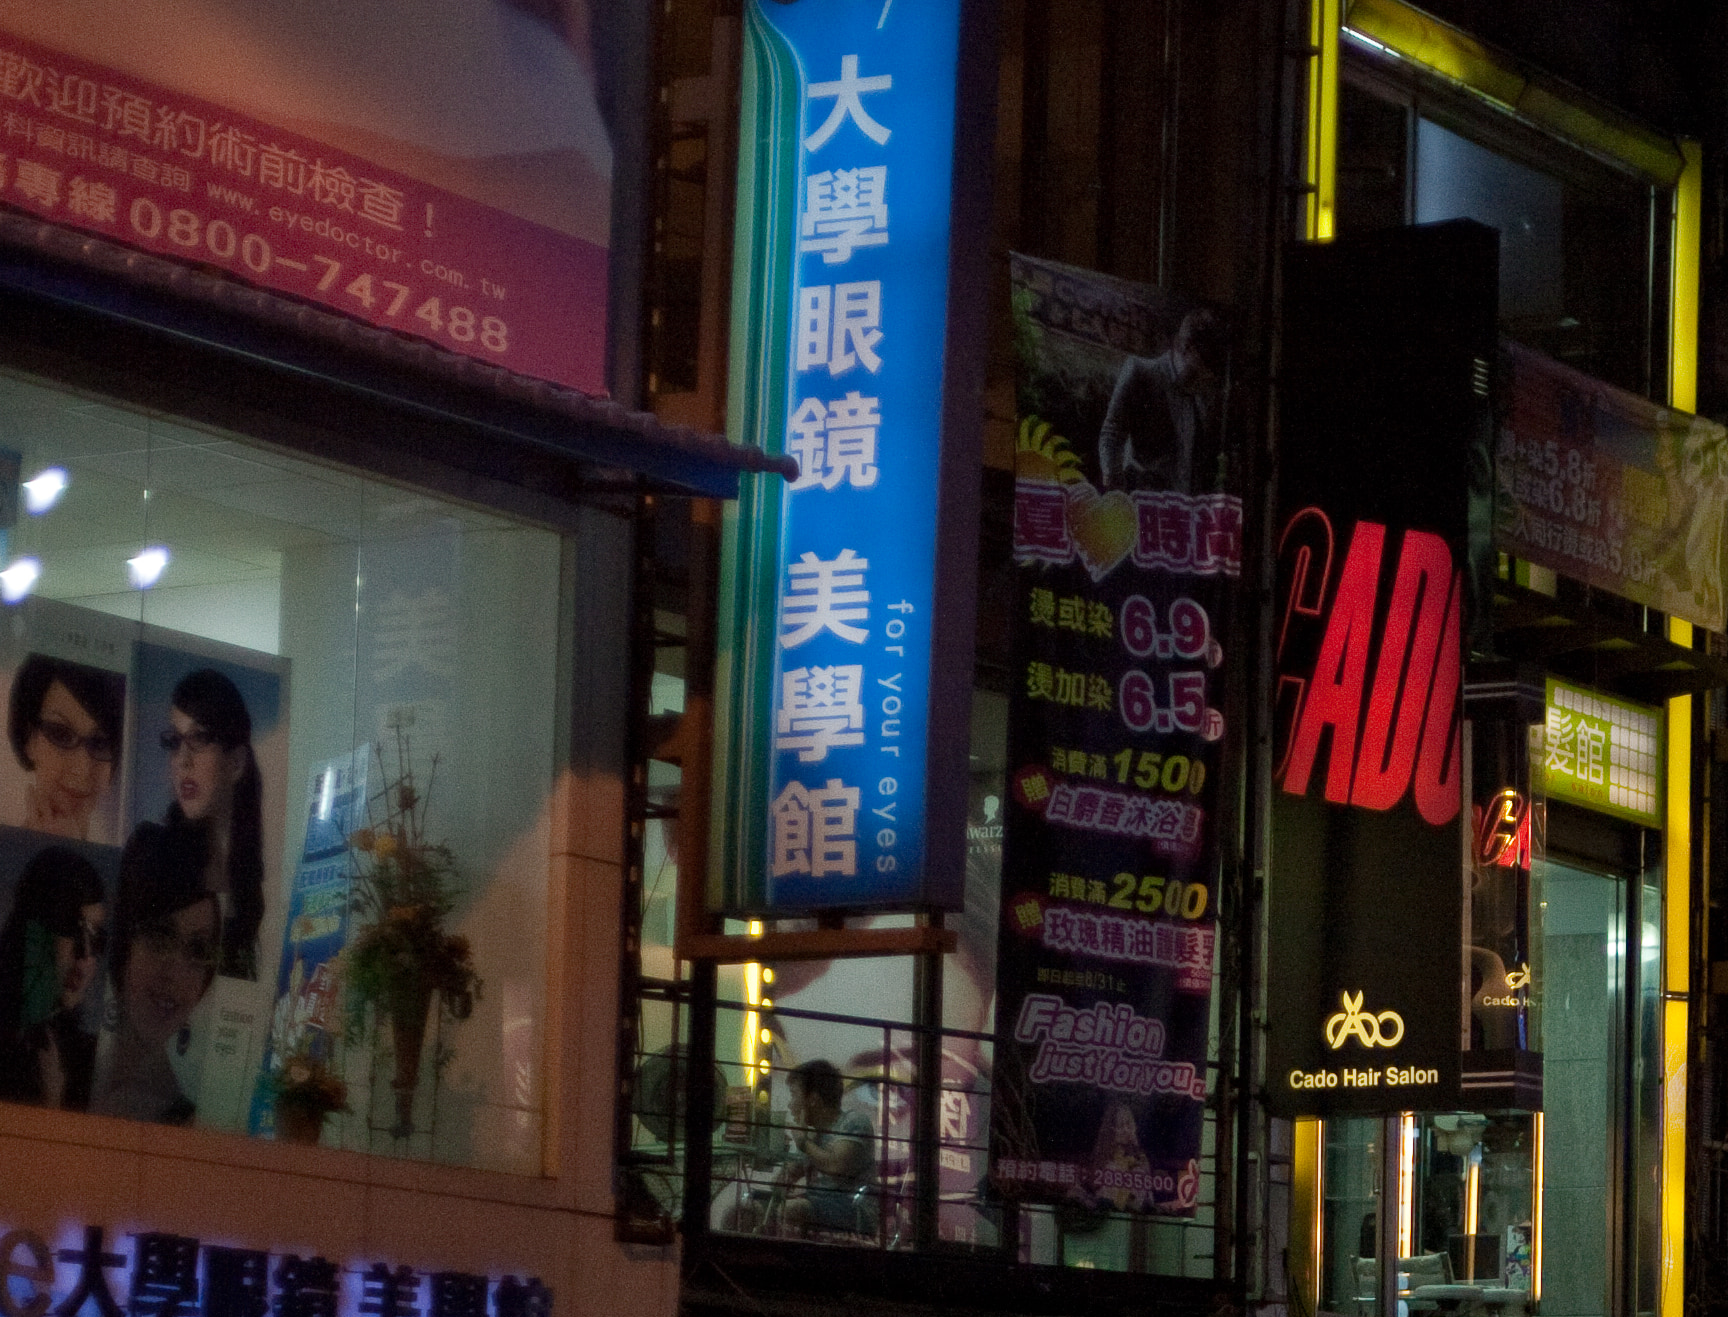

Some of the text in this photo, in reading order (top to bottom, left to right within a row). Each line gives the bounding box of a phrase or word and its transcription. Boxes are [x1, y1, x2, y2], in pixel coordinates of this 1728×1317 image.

[0, 153, 509, 354] 專線 0800-747488
[771, 54, 894, 879] 大學眼鏡 美學館
[871, 598, 916, 875] for your eyes
[1014, 992, 1167, 1058] Fashion
[1028, 1039, 1100, 1085] just
[1289, 1064, 1440, 1090] Cado Hair Salon
